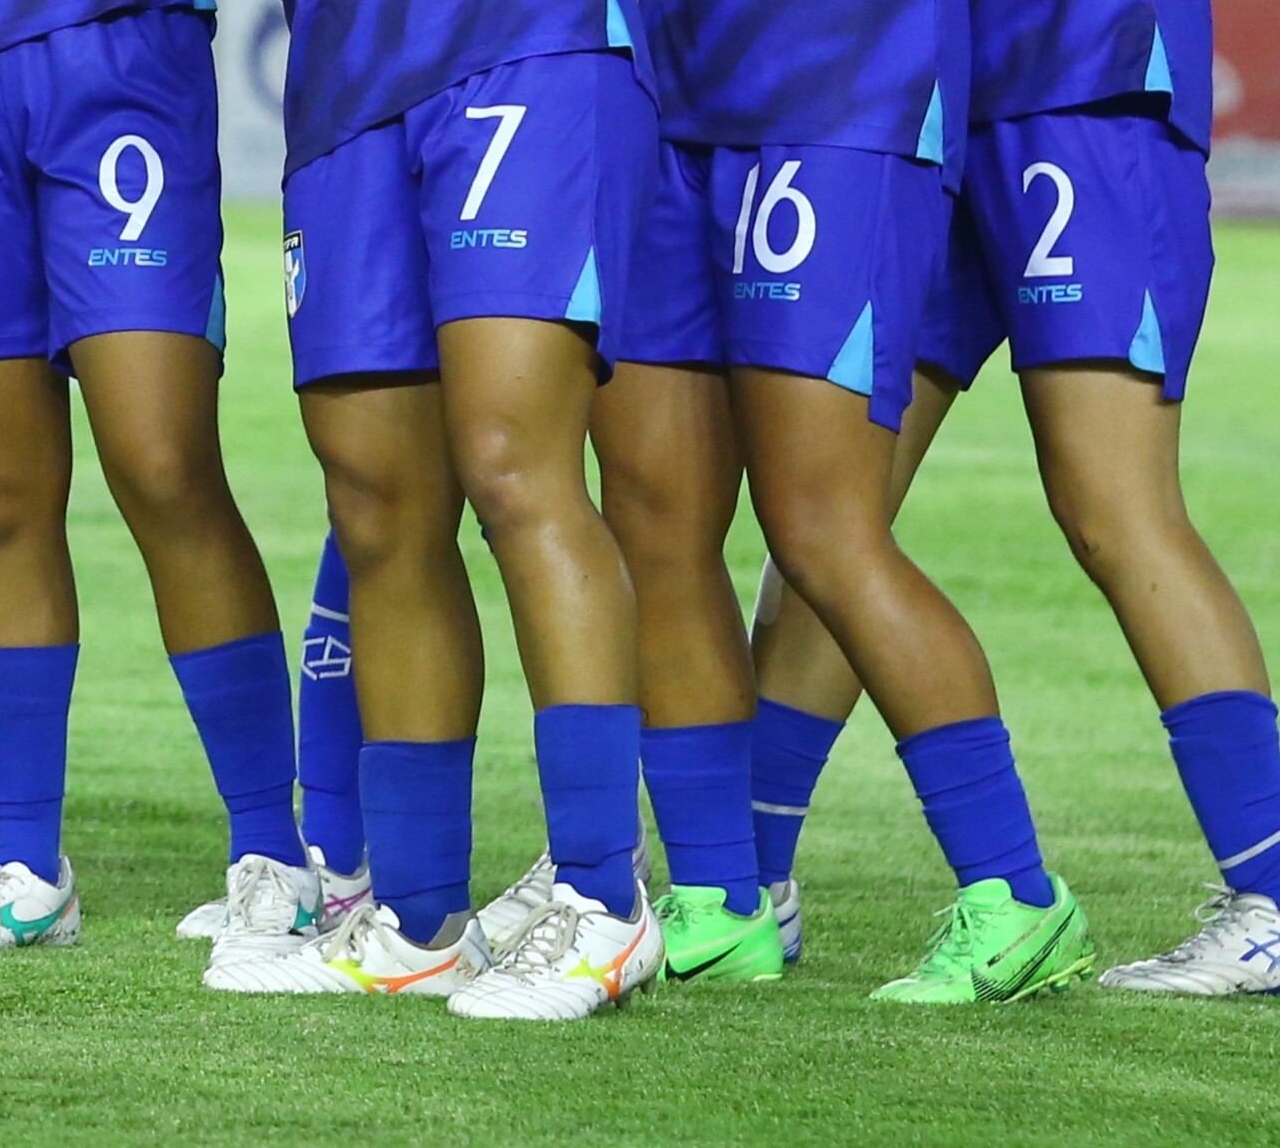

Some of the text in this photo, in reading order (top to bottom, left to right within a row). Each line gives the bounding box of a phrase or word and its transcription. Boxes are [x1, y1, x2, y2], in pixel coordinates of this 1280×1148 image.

[99, 134, 164, 241] 9
[460, 105, 527, 220] 7
[450, 229, 527, 249] ENTES
[732, 160, 816, 273] 16
[1023, 162, 1074, 277] 2
[88, 248, 167, 266] ENTES
[734, 281, 801, 301] ENTES
[1018, 283, 1082, 303] ENTES
